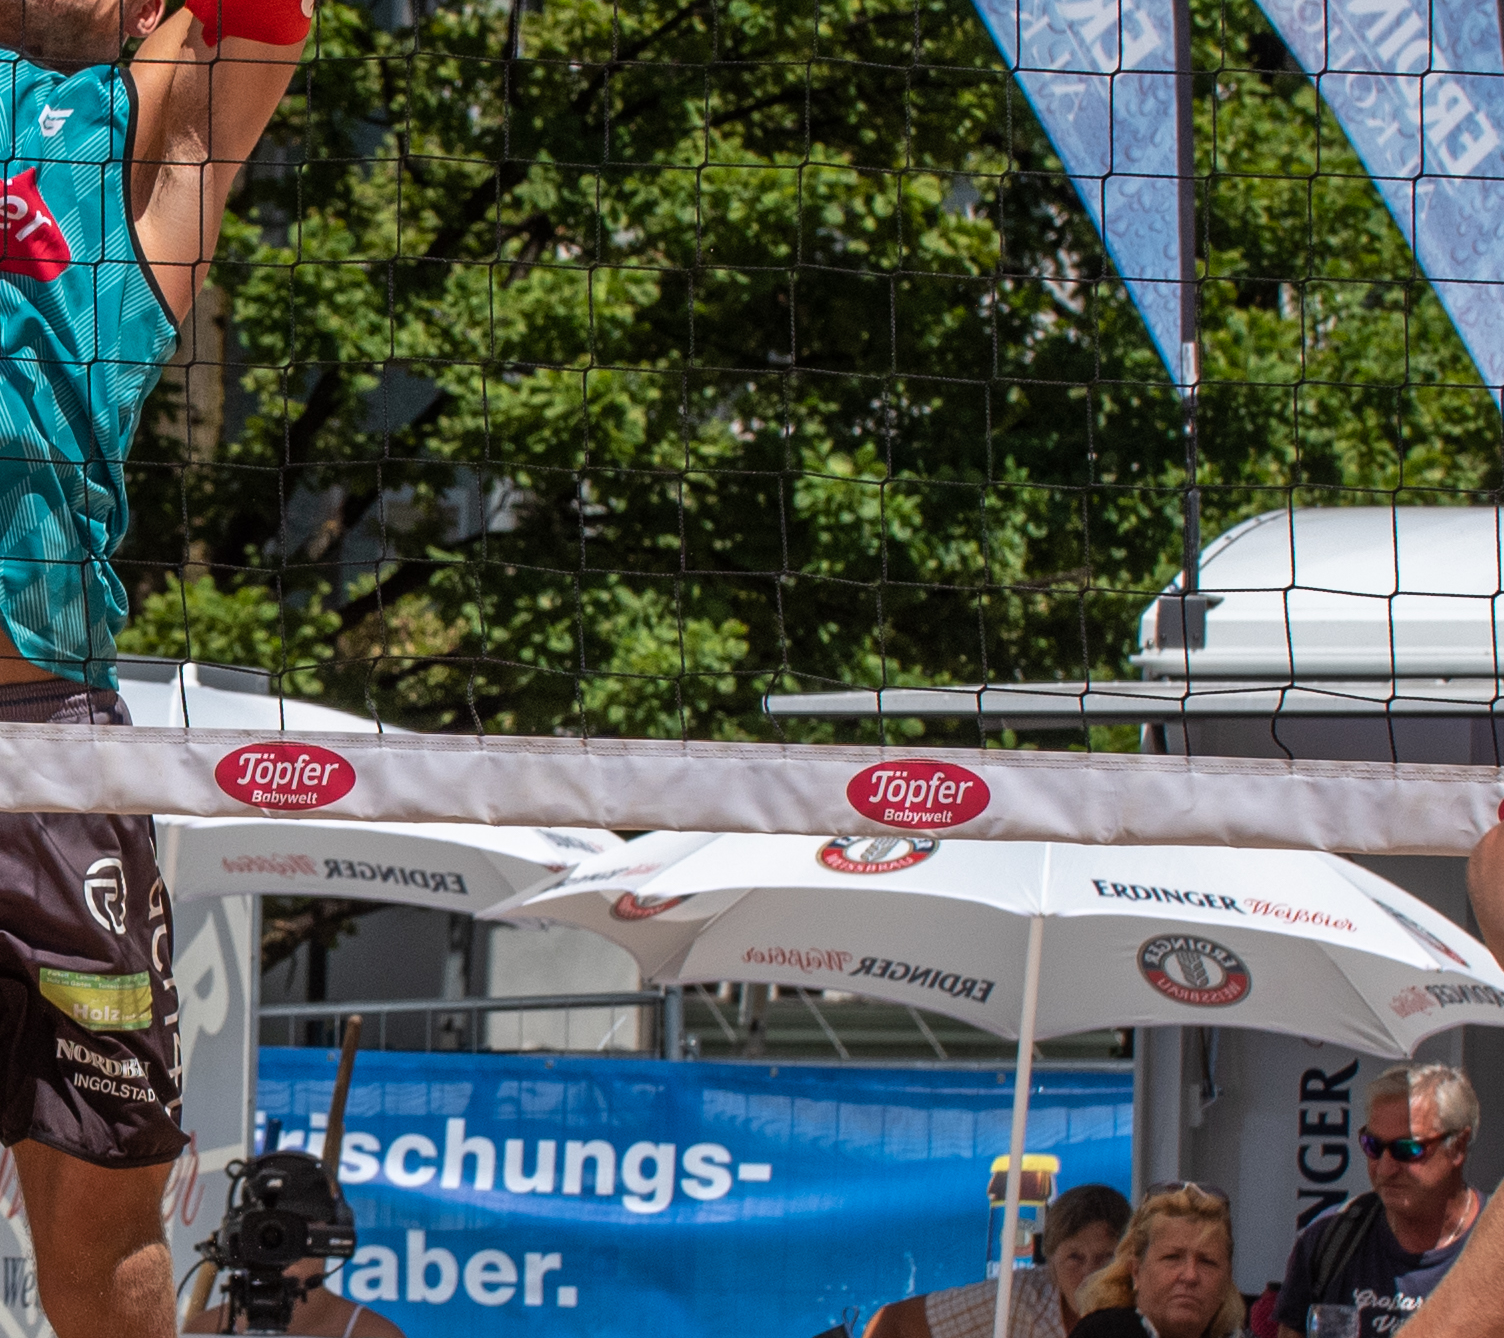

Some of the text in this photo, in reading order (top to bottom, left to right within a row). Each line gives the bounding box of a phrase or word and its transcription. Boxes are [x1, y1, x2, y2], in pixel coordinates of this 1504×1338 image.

[236, 752, 340, 790] Töpfer
[251, 789, 318, 805] Babywelt
[868, 770, 974, 808] Töpfer
[883, 808, 953, 825] Babywelt
[1091, 878, 1247, 915] ERDINGER
[1243, 897, 1358, 933] Weißbier
[72, 1003, 120, 1022] Holz
